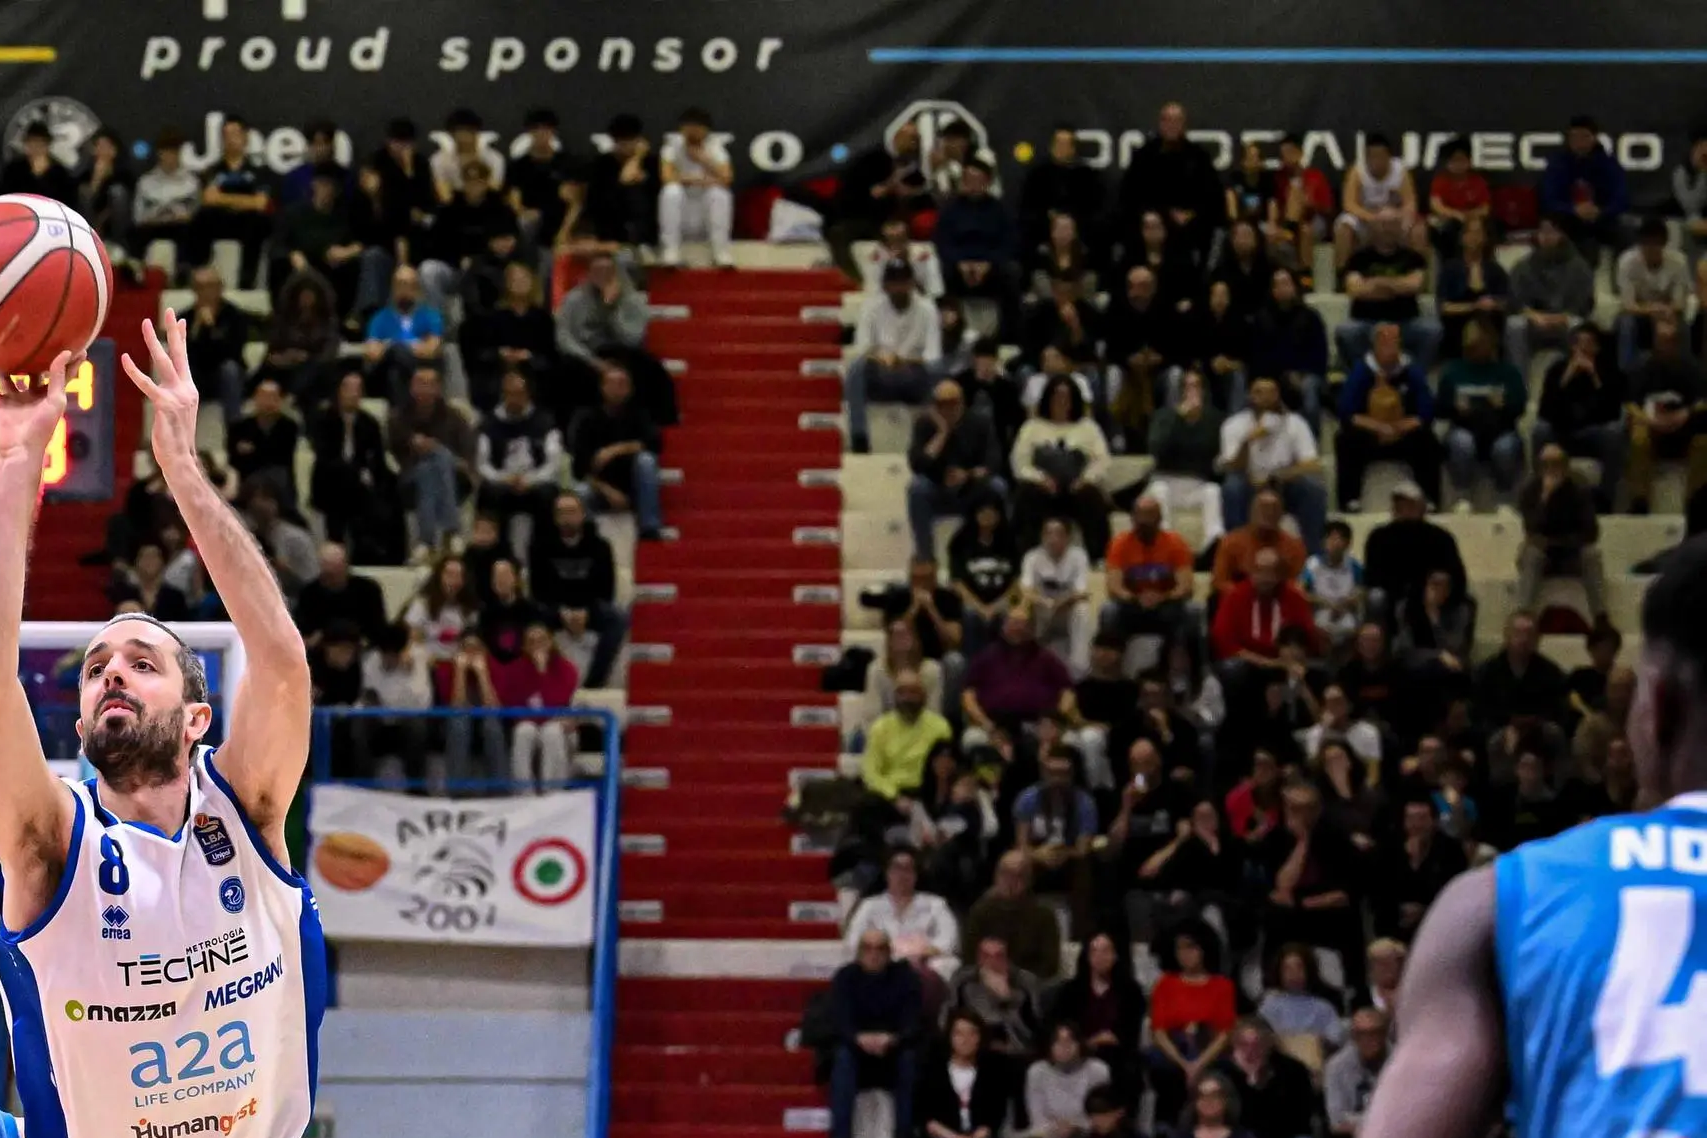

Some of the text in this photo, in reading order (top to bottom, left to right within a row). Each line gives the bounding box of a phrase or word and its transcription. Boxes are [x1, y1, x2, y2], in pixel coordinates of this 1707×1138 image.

[141, 27, 784, 80] proud sponsor
[201, 831, 226, 846] LBA
[99, 833, 130, 895] 8
[102, 926, 132, 940] errea
[185, 927, 245, 954] METROLOGIA
[117, 934, 249, 986] TECHNE
[204, 954, 283, 1011] MEGRANI
[87, 1001, 177, 1022] mazza
[129, 1019, 256, 1089] a2a
[135, 1069, 256, 1108] LIFE COMPANY
